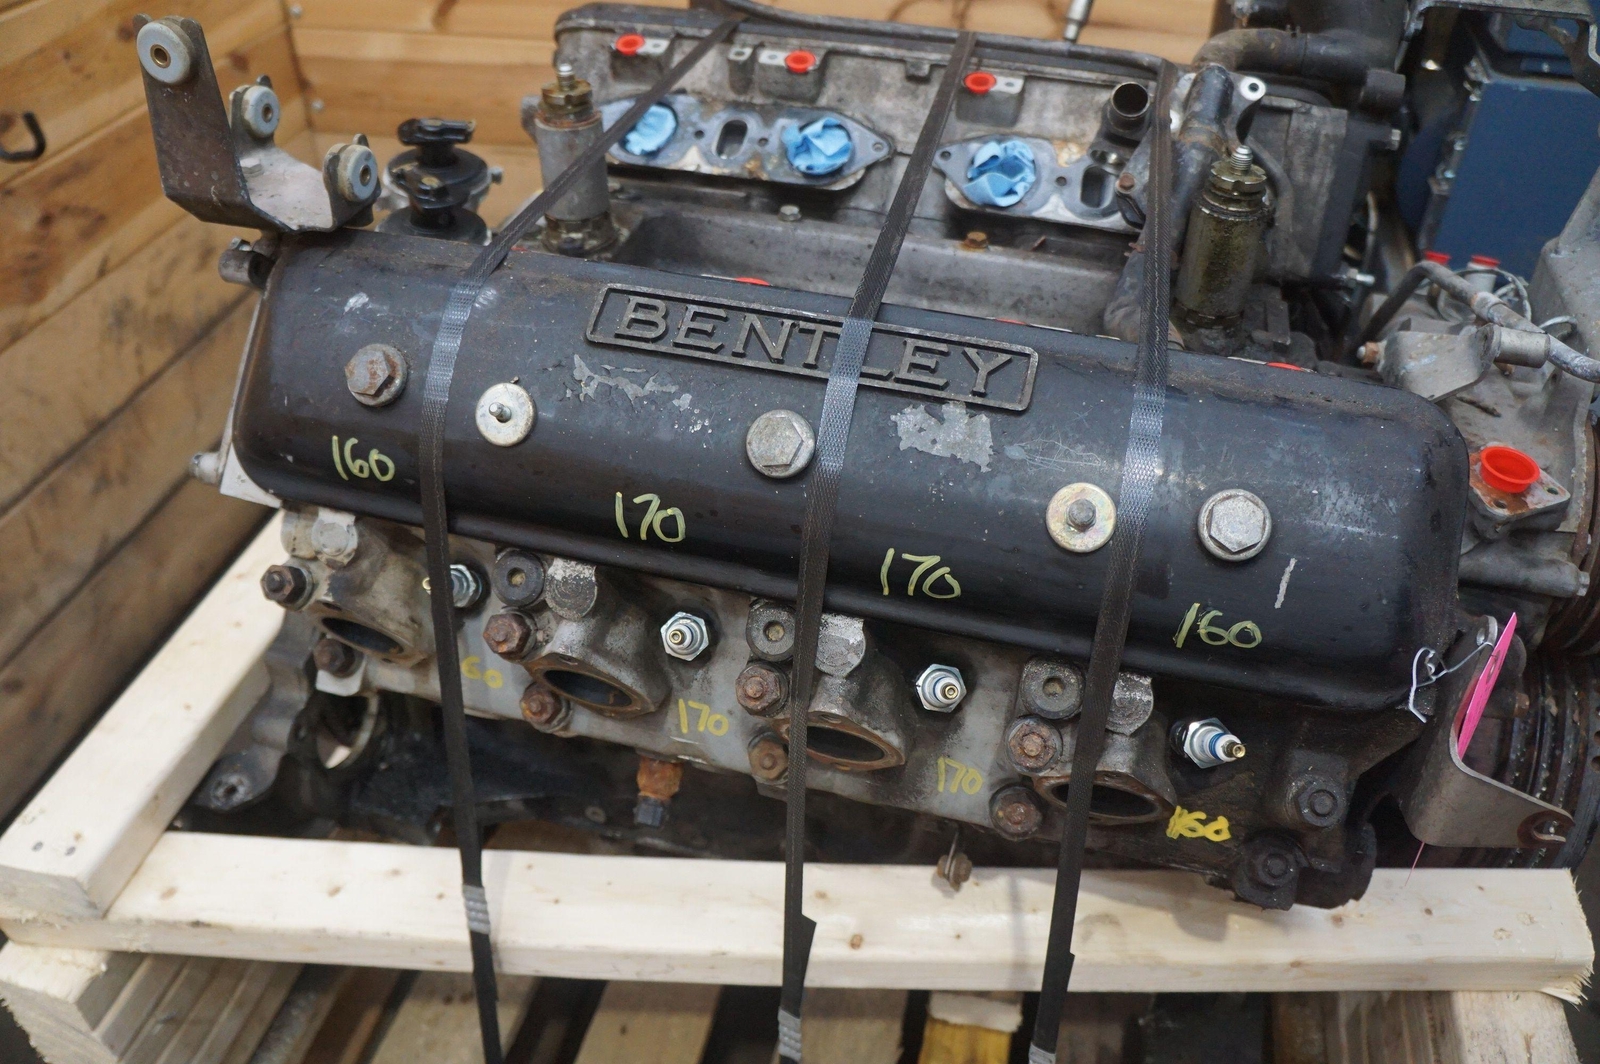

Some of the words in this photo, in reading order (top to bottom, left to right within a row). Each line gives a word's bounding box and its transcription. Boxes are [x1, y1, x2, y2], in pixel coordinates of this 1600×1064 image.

[332, 435, 395, 482] 160
[615, 491, 686, 543] 170
[880, 548, 961, 598] 170
[1173, 602, 1262, 649] 160
[461, 655, 504, 689] 60
[678, 698, 729, 736] 170
[937, 756, 983, 796] 170
